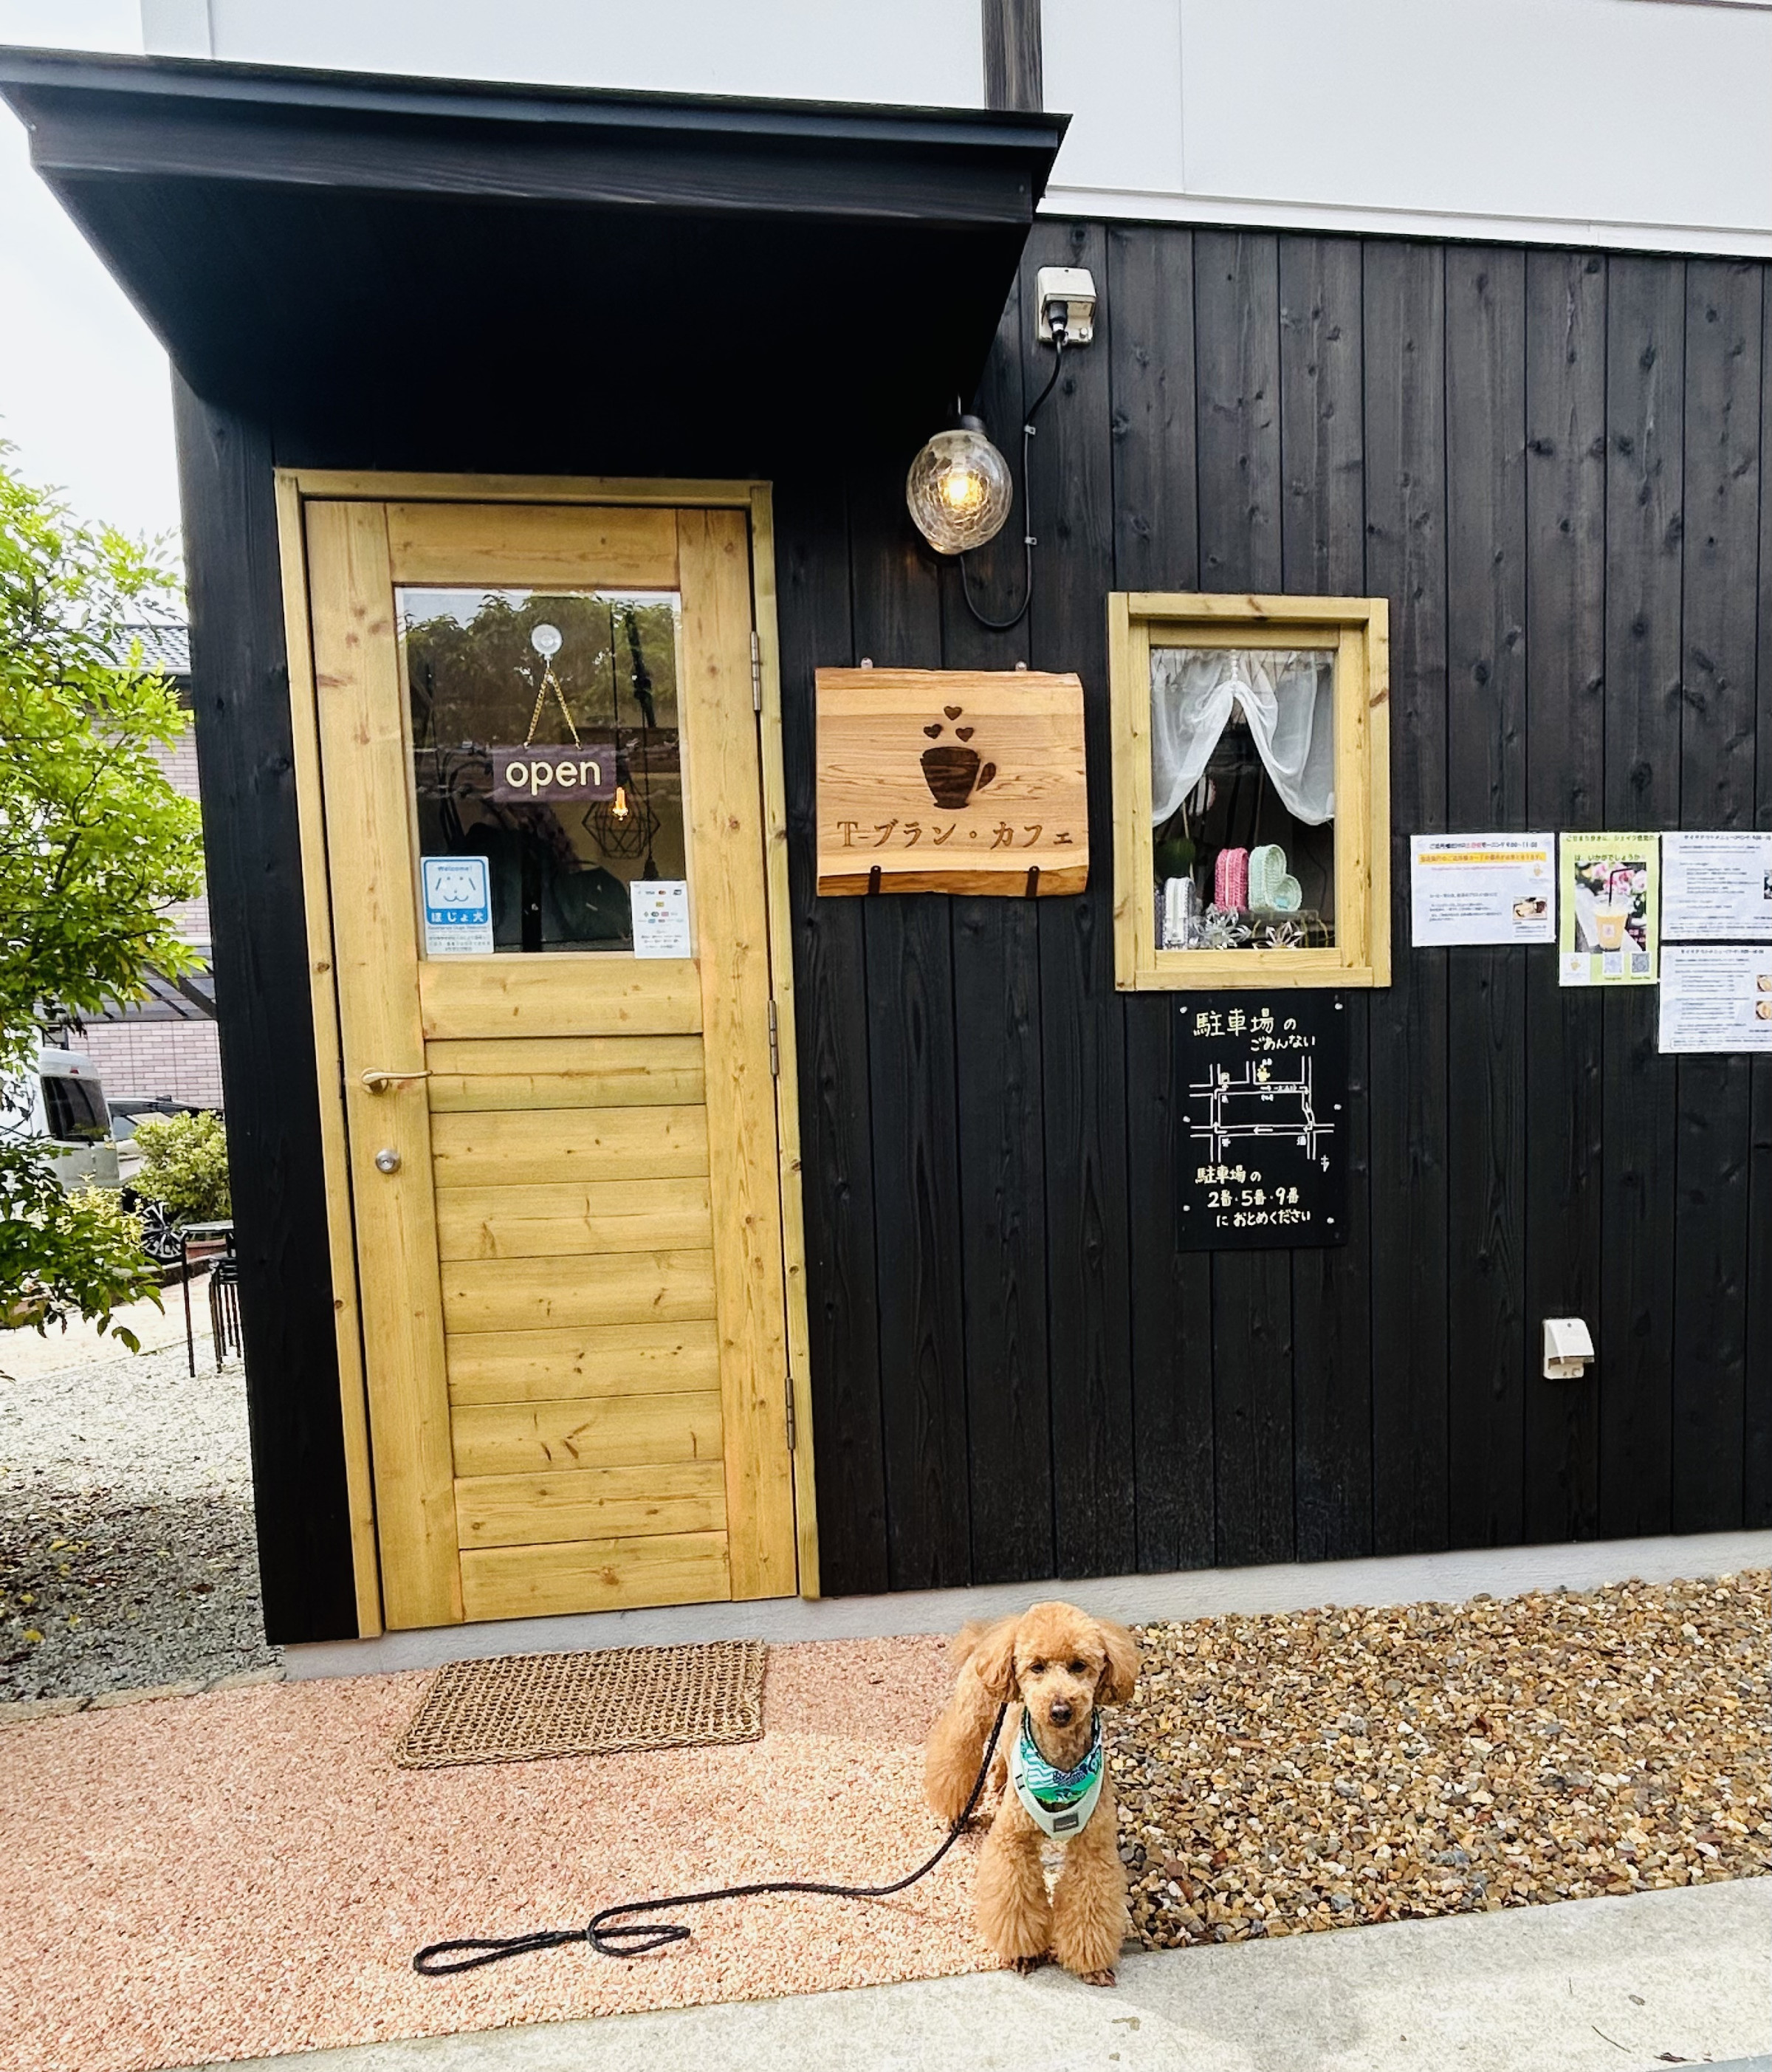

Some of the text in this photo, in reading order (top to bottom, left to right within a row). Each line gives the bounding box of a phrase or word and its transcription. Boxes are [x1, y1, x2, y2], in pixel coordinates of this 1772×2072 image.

[506, 761, 601, 796] open
[430, 911, 484, 923] ほじょ犬
[1250, 1034, 1316, 1052] ごあんない
